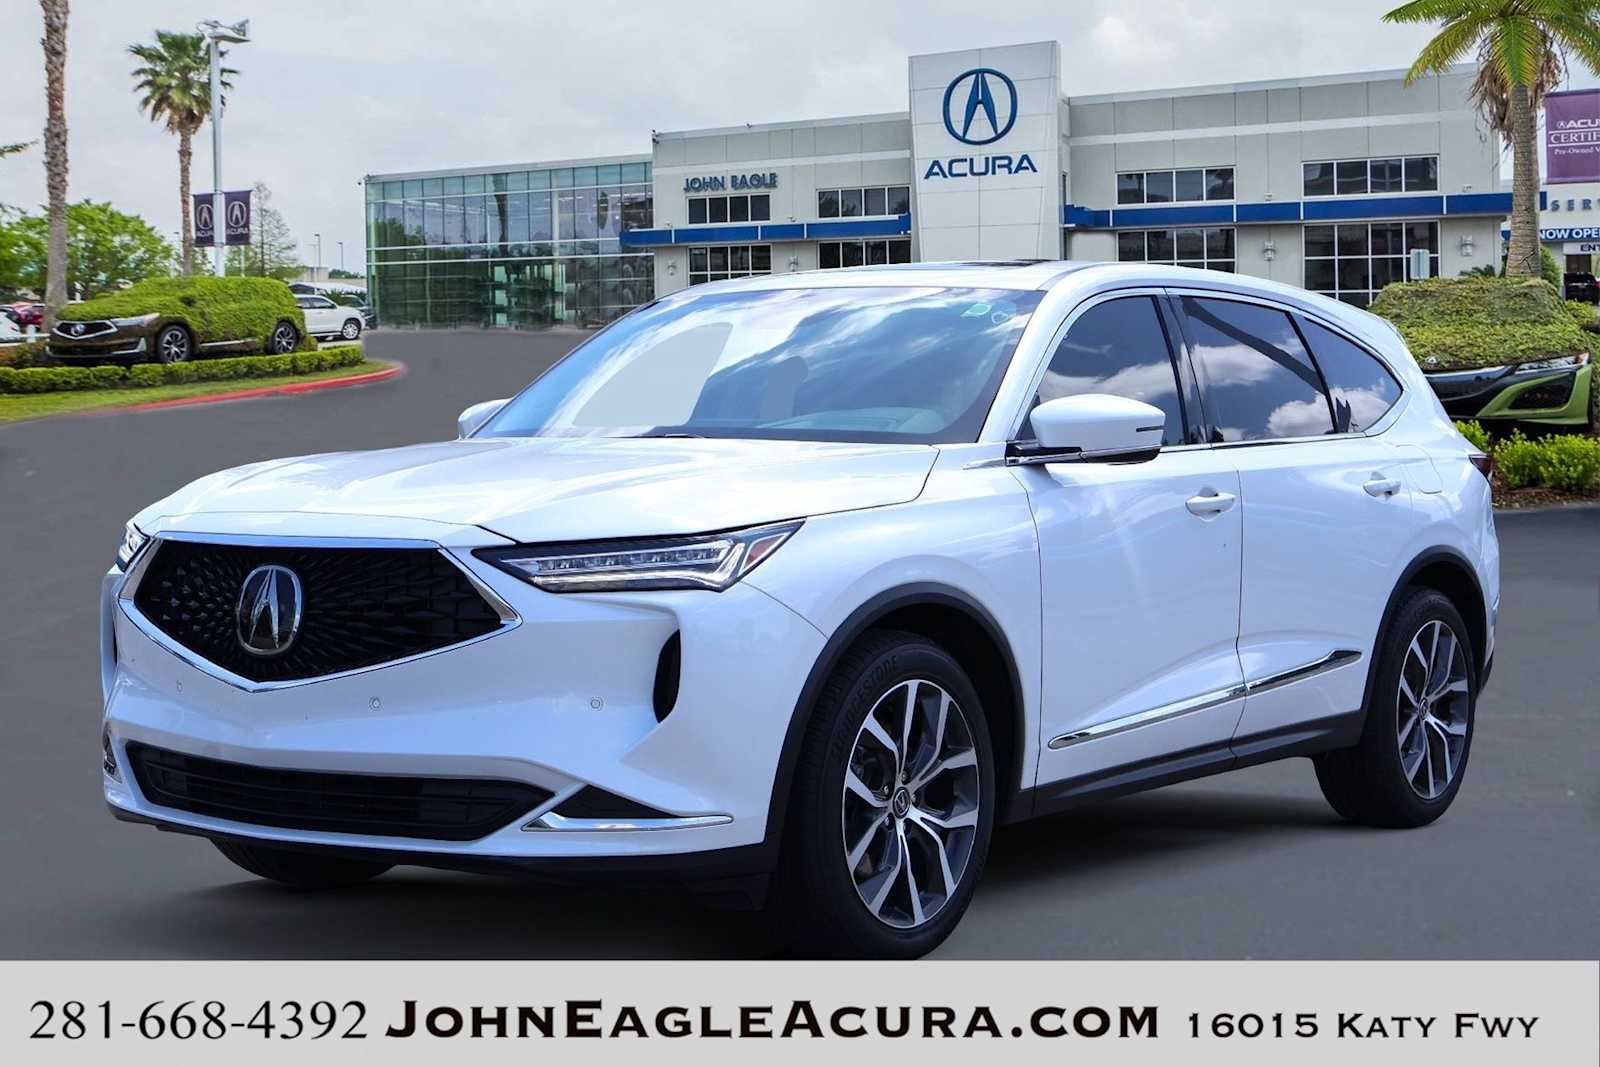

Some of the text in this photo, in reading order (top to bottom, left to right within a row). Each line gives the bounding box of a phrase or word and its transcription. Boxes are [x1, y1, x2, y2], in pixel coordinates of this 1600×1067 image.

[1566, 118, 1600, 129] ACU
[923, 153, 1039, 180] ACURA
[683, 172, 778, 193] JOHN EAGLE
[1540, 228, 1600, 240] NOW OPE
